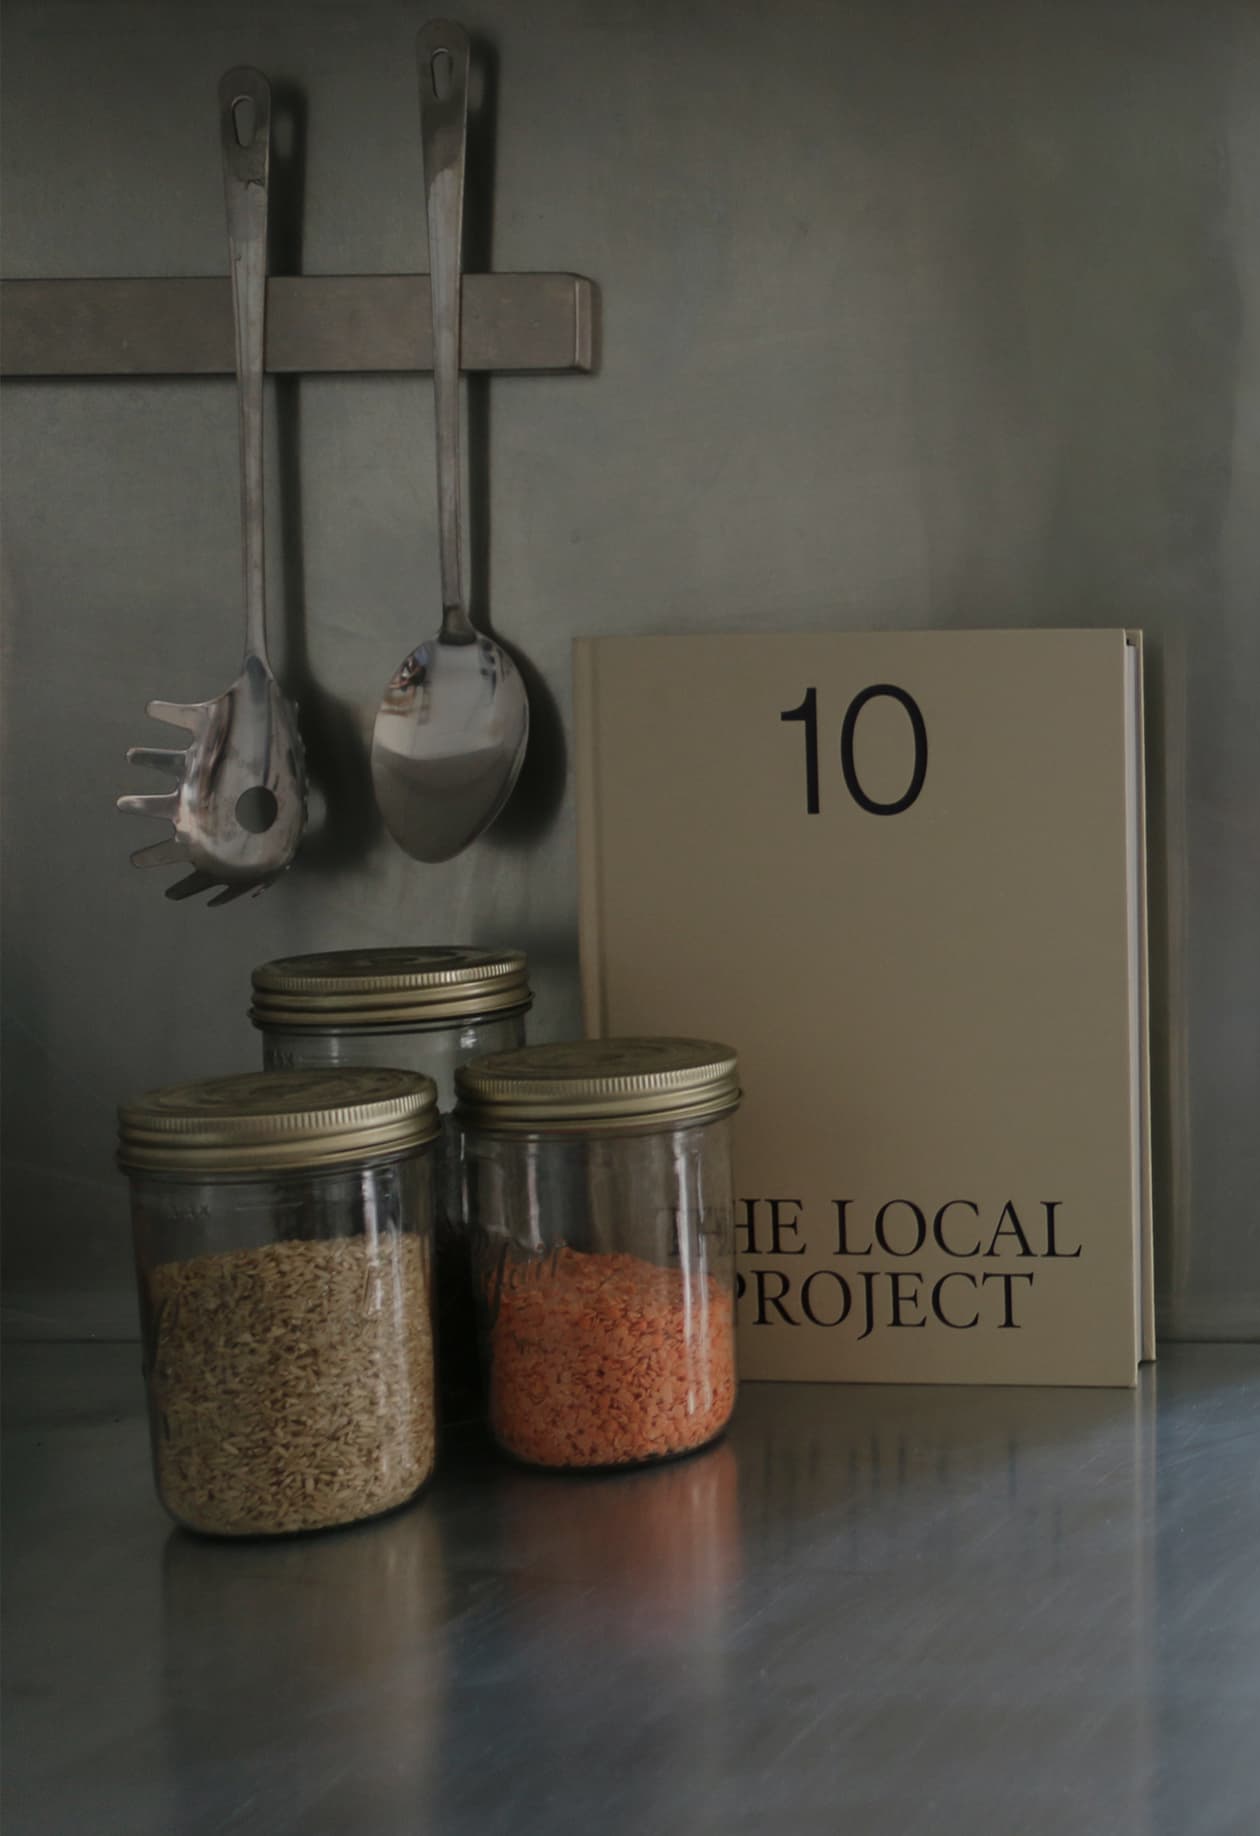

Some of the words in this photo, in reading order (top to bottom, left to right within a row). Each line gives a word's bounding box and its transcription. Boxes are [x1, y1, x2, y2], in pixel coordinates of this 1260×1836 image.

[780, 683, 928, 816] 10
[734, 1197, 807, 1255] HE
[833, 1199, 1083, 1258] LOCAL
